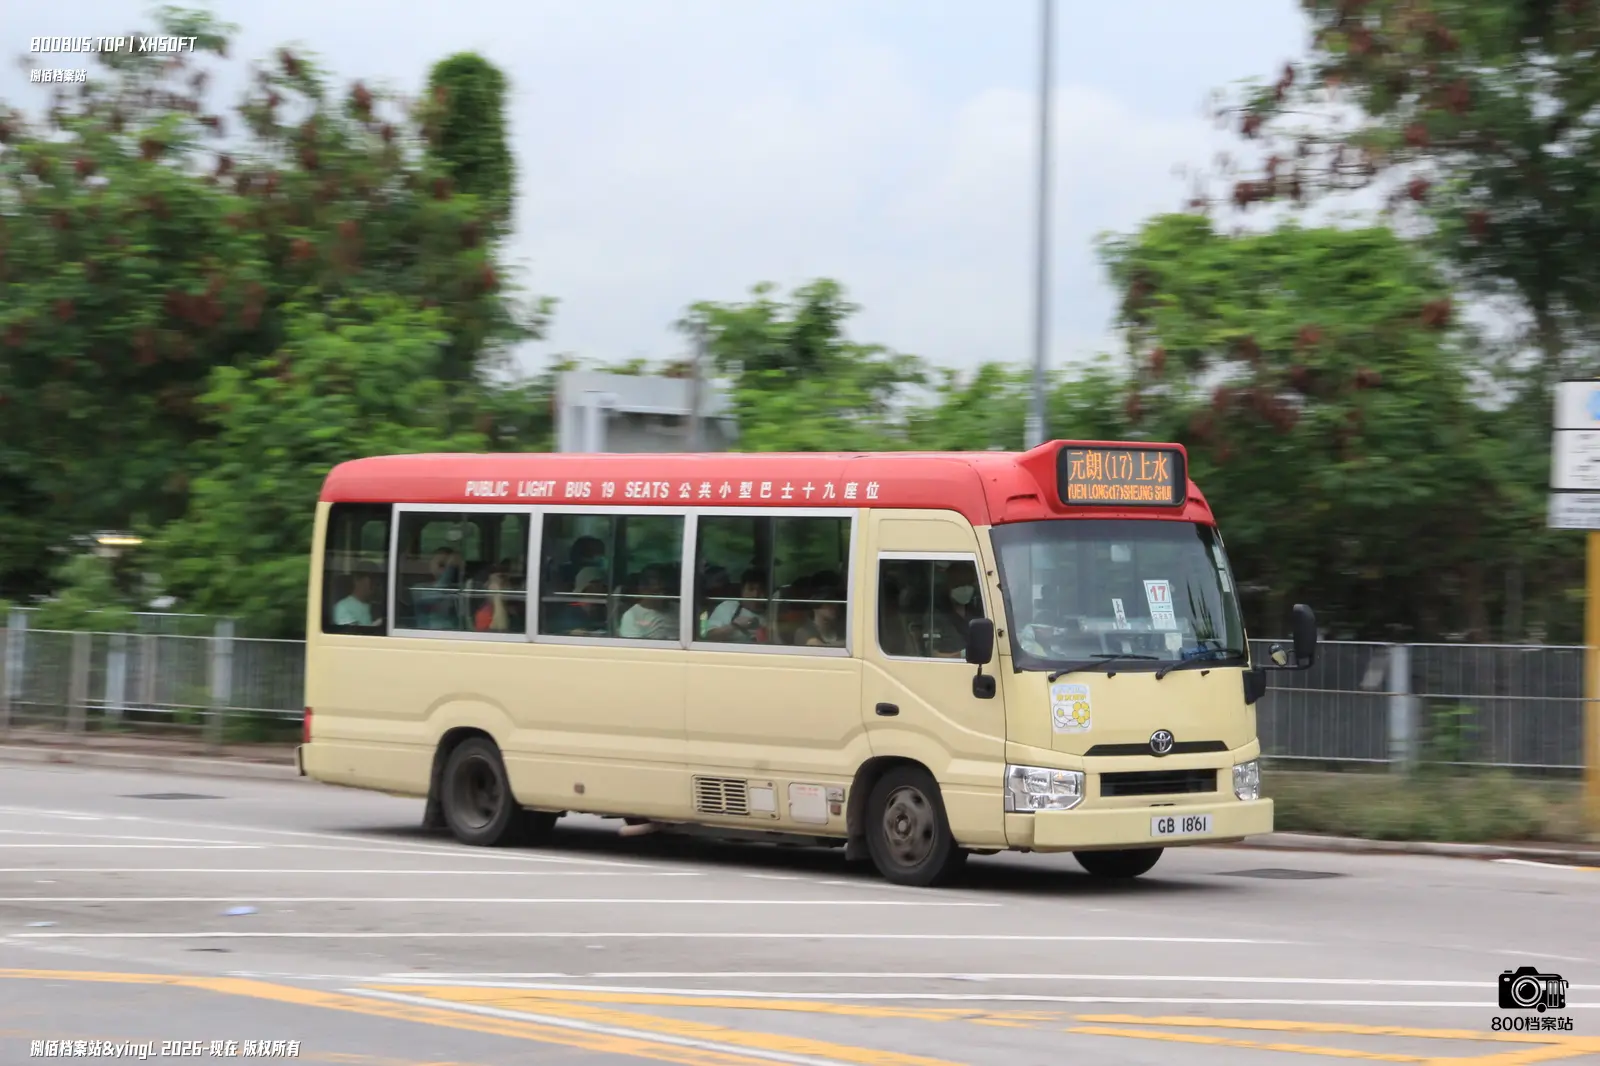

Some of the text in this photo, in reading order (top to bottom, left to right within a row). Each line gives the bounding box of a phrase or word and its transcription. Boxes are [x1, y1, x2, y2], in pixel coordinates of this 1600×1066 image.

[1069, 450, 1169, 483] 元朗(17)上水
[465, 480, 670, 498] PUBLIC LIGHT BUS 19 SEATS
[679, 481, 880, 499] 公共小型巴士十九座位
[1068, 484, 1087, 499] YUEN
[1155, 485, 1172, 500] SHUI
[1150, 585, 1166, 601] 17
[1158, 816, 1206, 833] GB 1861
